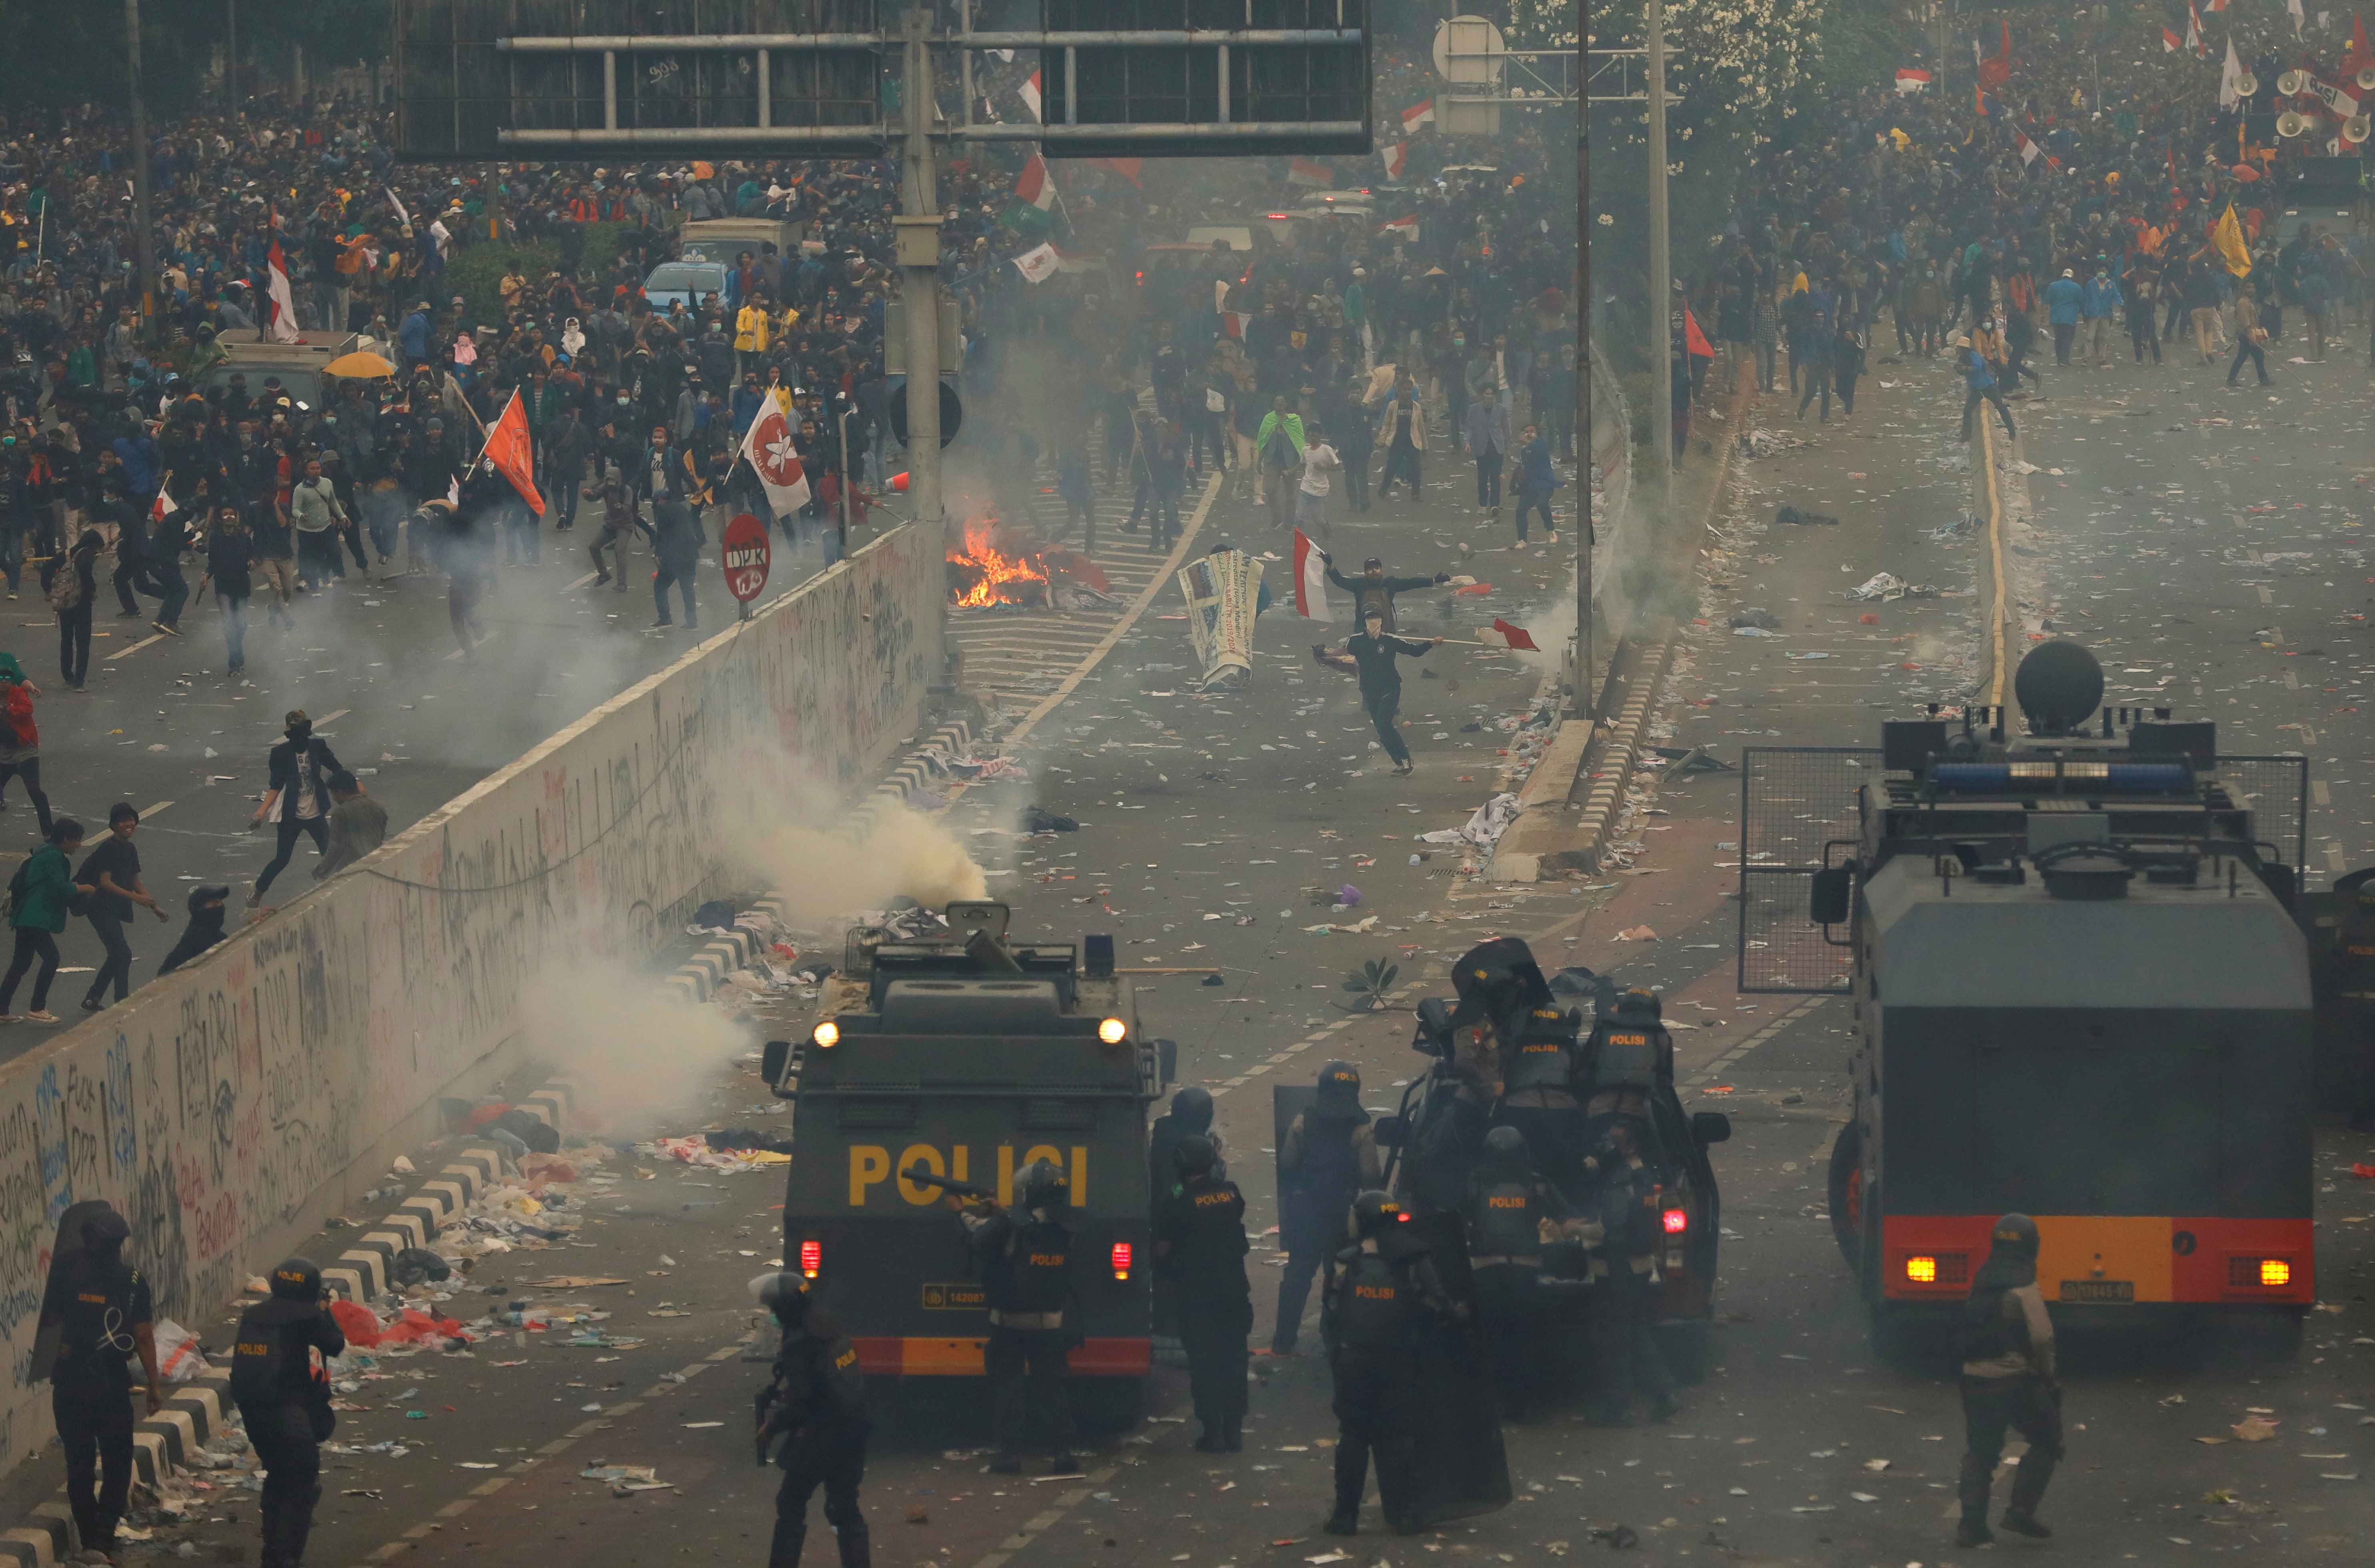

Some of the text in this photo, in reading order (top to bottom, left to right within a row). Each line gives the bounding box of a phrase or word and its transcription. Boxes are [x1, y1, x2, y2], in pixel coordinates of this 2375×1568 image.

[730, 537, 769, 572] DPR
[1226, 620, 1236, 654] 2019/2020
[1533, 1009, 1559, 1020] POLISI
[1610, 1035, 1645, 1046] POLISI
[1523, 1044, 1559, 1054] POLISI
[72, 1125, 101, 1194] DPR
[1194, 1193, 1232, 1208] POLISI
[1489, 1197, 1526, 1209] POLISI
[1030, 1254, 1064, 1266] POLISI
[277, 1270, 305, 1283] POLISI
[1355, 1286, 1395, 1300] POLISI
[238, 1343, 268, 1356] POLISI
